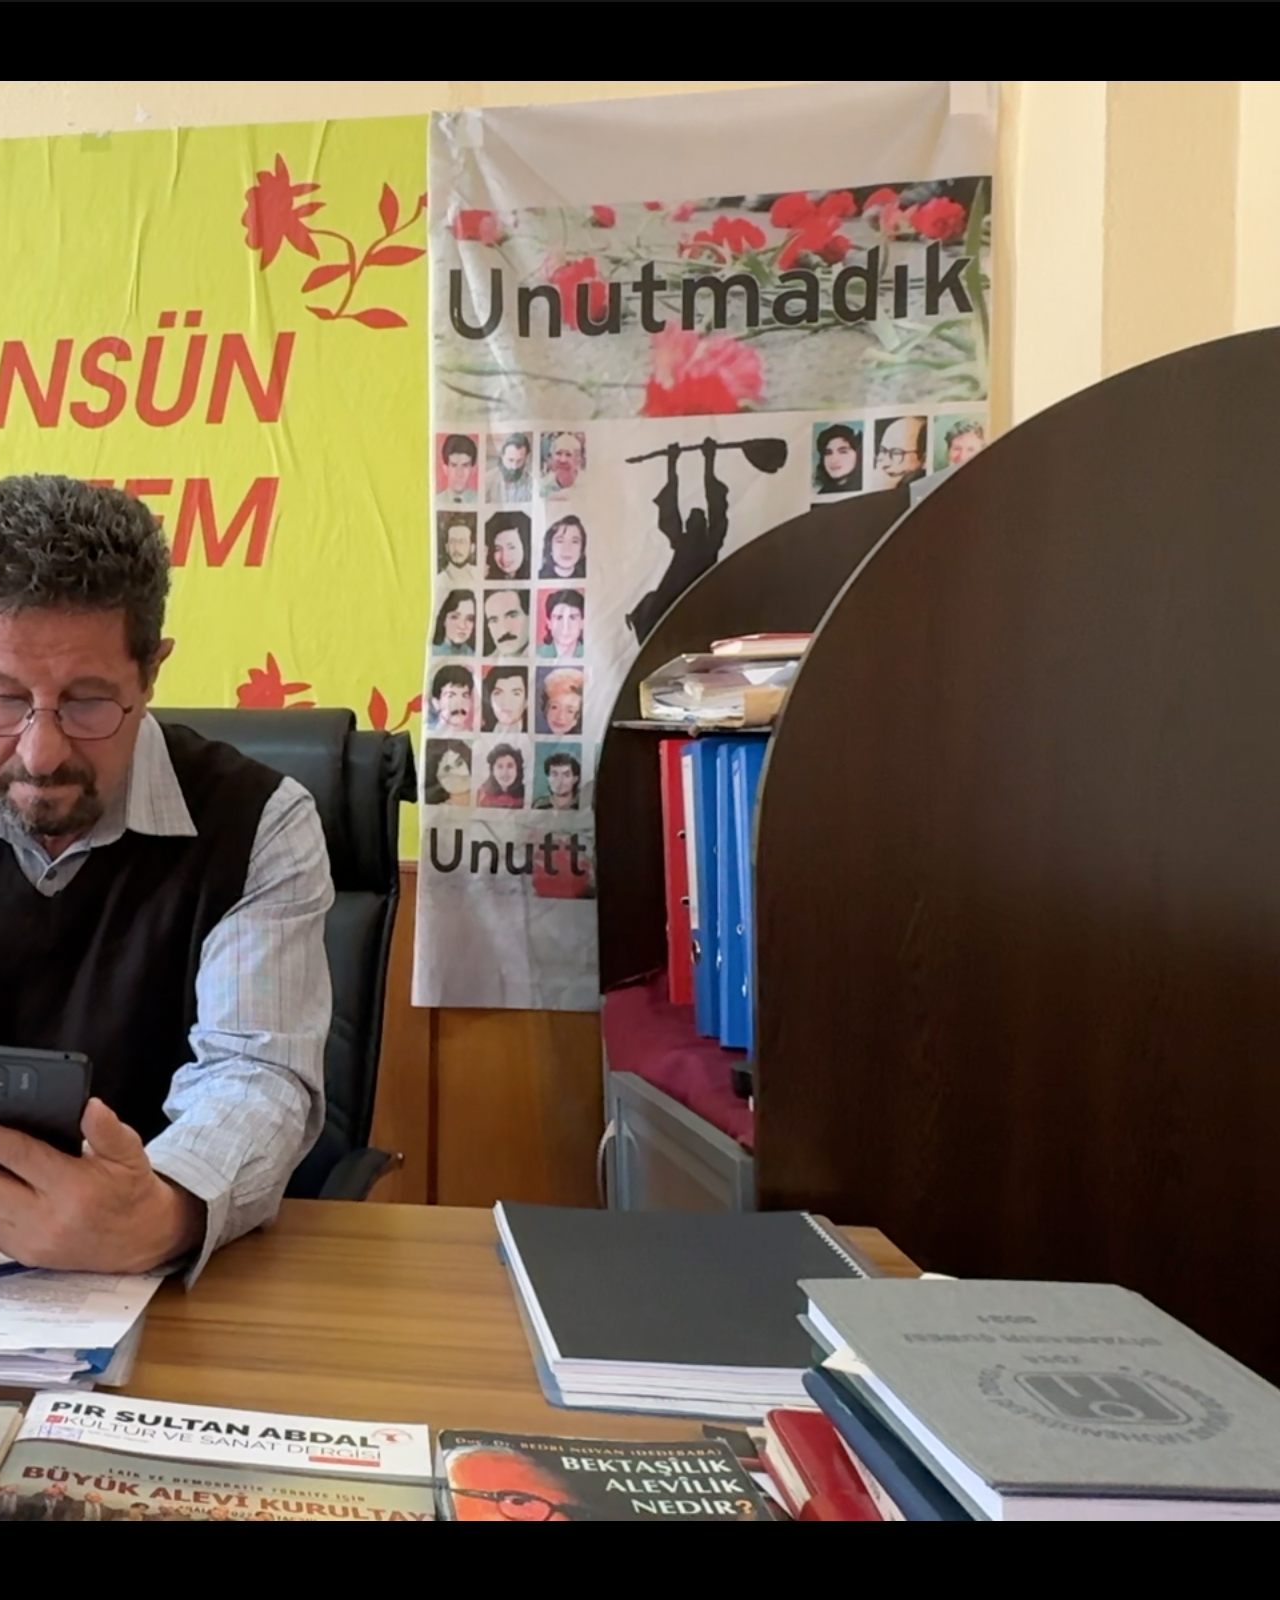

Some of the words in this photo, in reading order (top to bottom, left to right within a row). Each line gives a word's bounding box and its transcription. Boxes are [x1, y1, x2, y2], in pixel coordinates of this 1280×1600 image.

[449, 240, 974, 340] Unutmadık
[429, 828, 588, 877] Unutt
[114, 1411, 251, 1437] SULTAN
[258, 1426, 381, 1450] ABDAL
[162, 1430, 193, 1443] VE
[200, 1434, 282, 1453] SANAT
[22, 1465, 141, 1498] BÜYÜK
[149, 1485, 249, 1509] ALEVİ
[631, 1497, 755, 1516] NEDİR?
